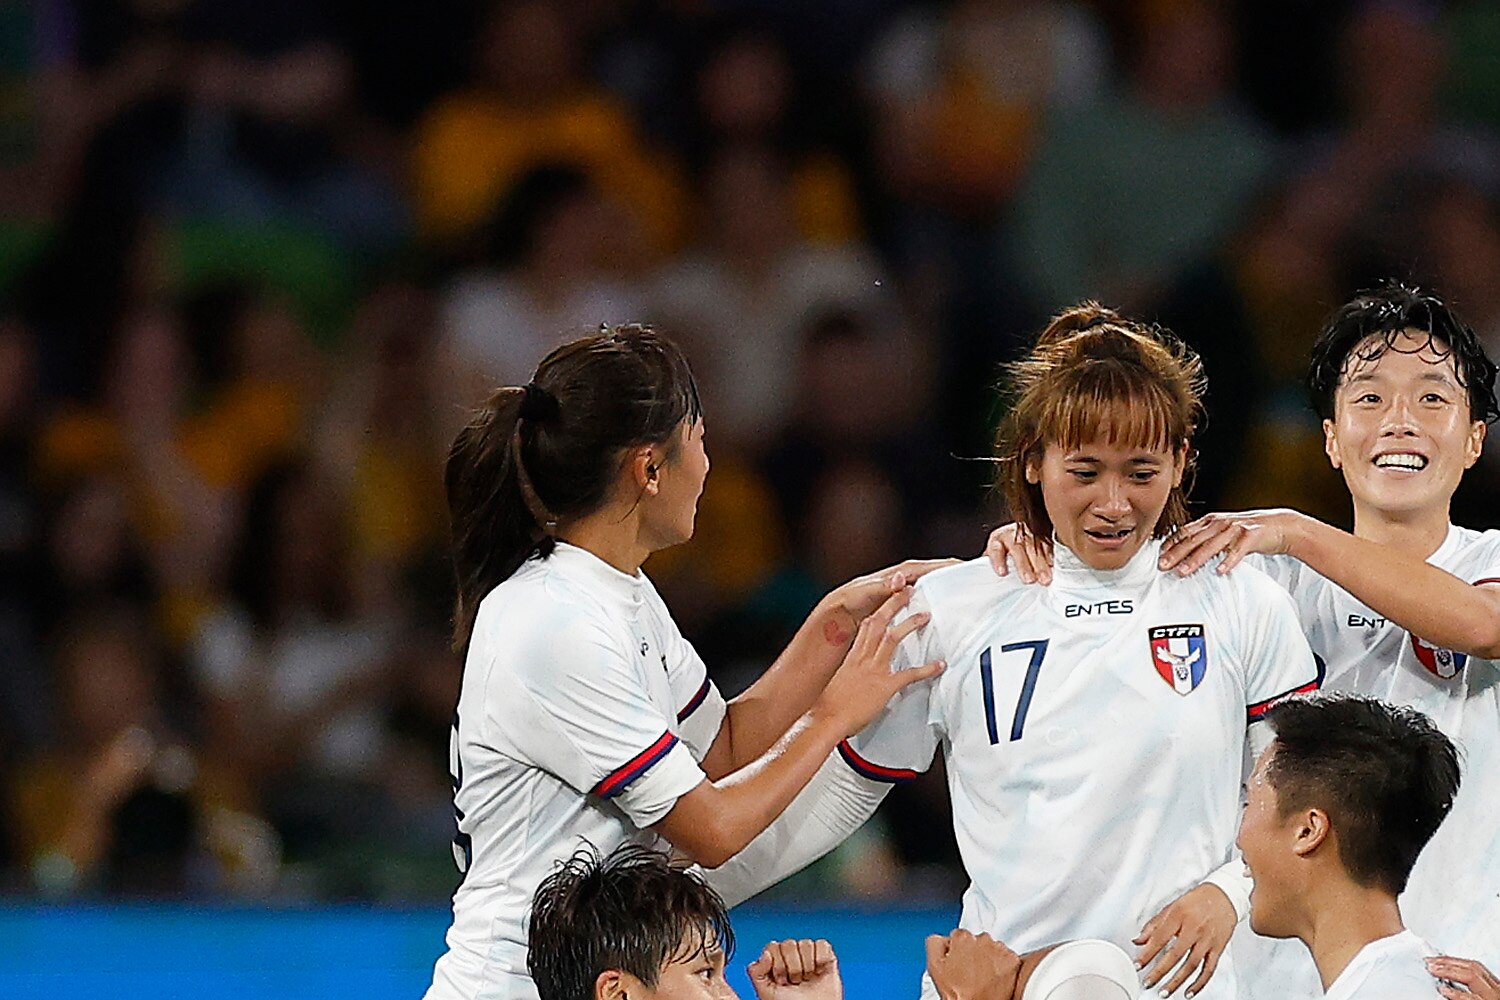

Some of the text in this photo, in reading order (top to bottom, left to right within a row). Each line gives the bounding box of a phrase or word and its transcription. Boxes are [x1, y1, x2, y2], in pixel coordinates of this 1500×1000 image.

[1065, 599, 1133, 618] ENTES
[1347, 614, 1388, 629] ENT
[1153, 626, 1201, 638] CTFA
[979, 638, 1051, 746] 17
